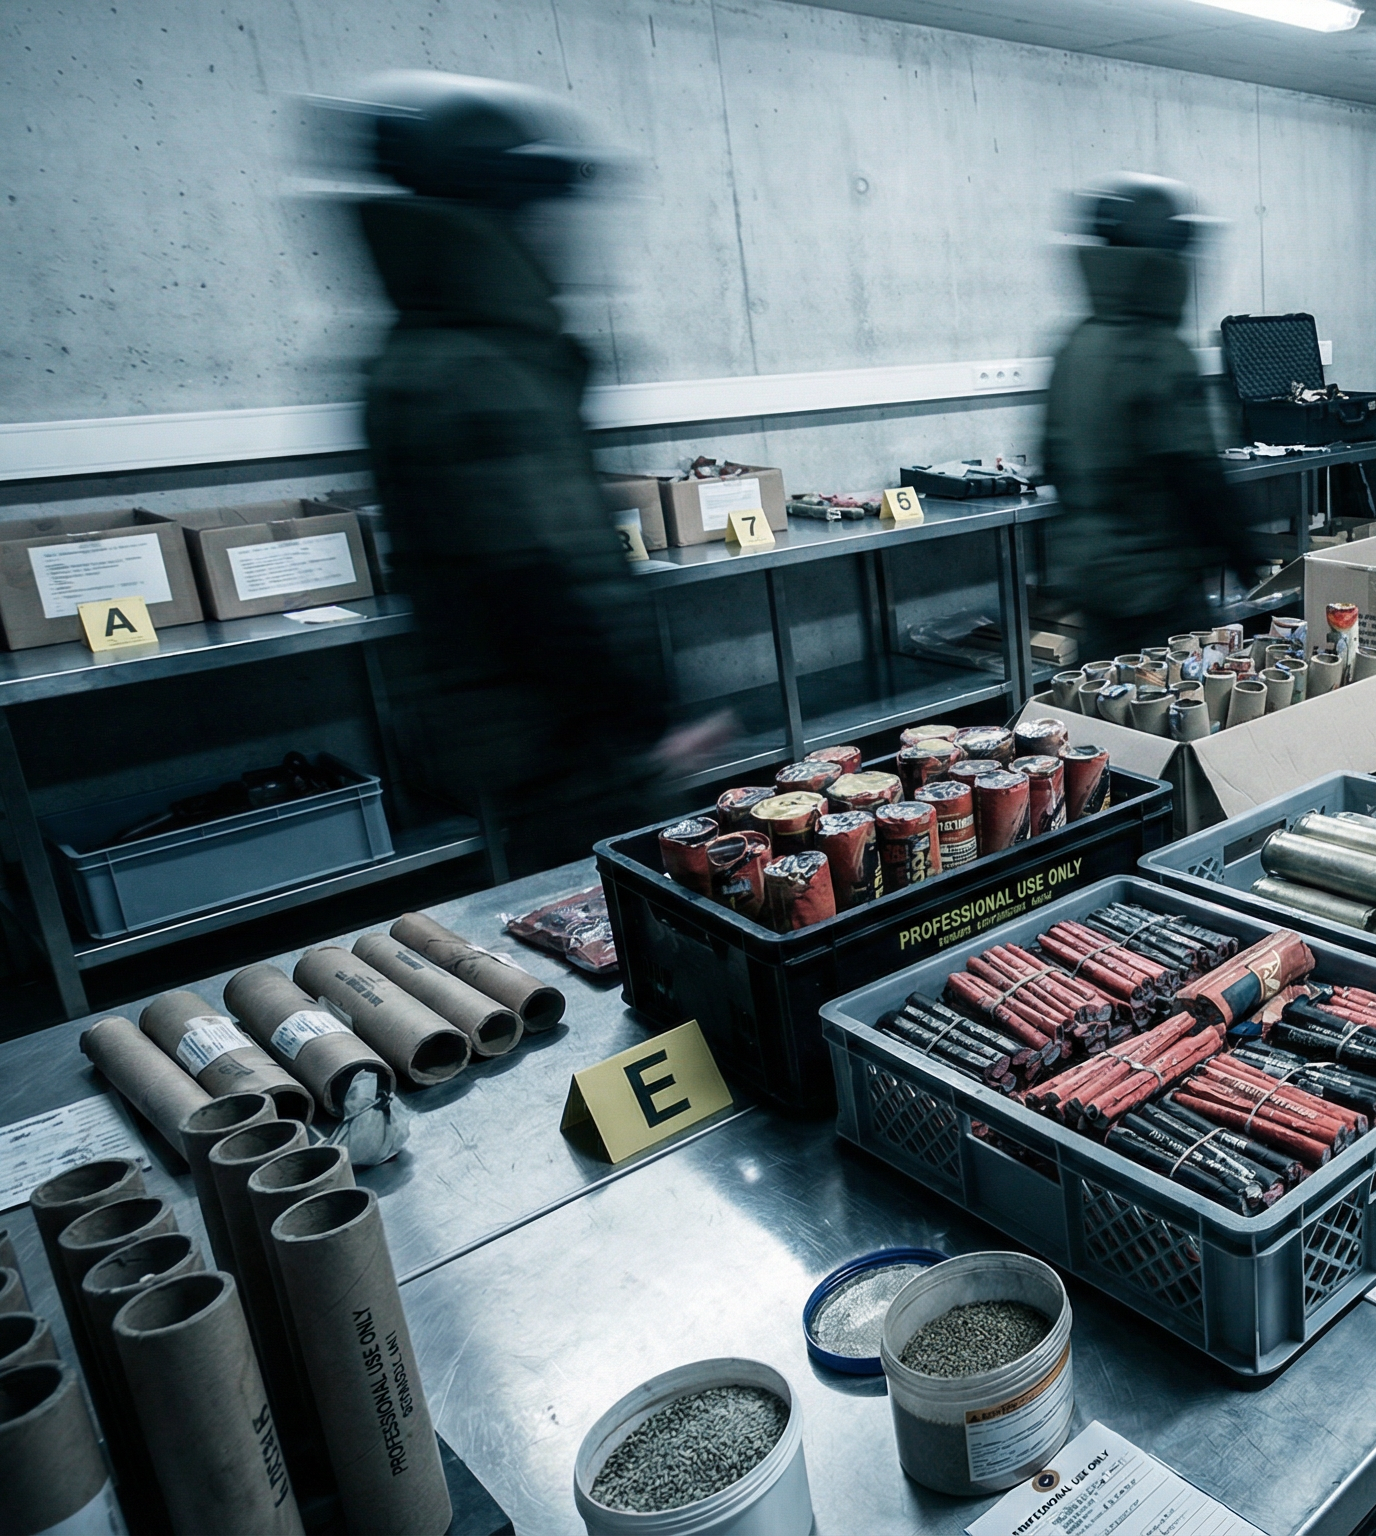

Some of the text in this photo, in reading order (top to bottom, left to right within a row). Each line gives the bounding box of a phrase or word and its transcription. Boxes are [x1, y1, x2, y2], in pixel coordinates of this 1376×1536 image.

[896, 491, 912, 511] 6
[741, 516, 756, 537] 7
[105, 607, 138, 637] A
[899, 888, 1014, 950] PROFESSIONAL
[1017, 873, 1044, 898] USE
[1048, 857, 1082, 885] ONLY
[623, 1048, 692, 1129] E
[352, 1306, 377, 1346] ONLY
[362, 1343, 384, 1377] USE
[371, 1372, 409, 1477] PROFESSIONAL
